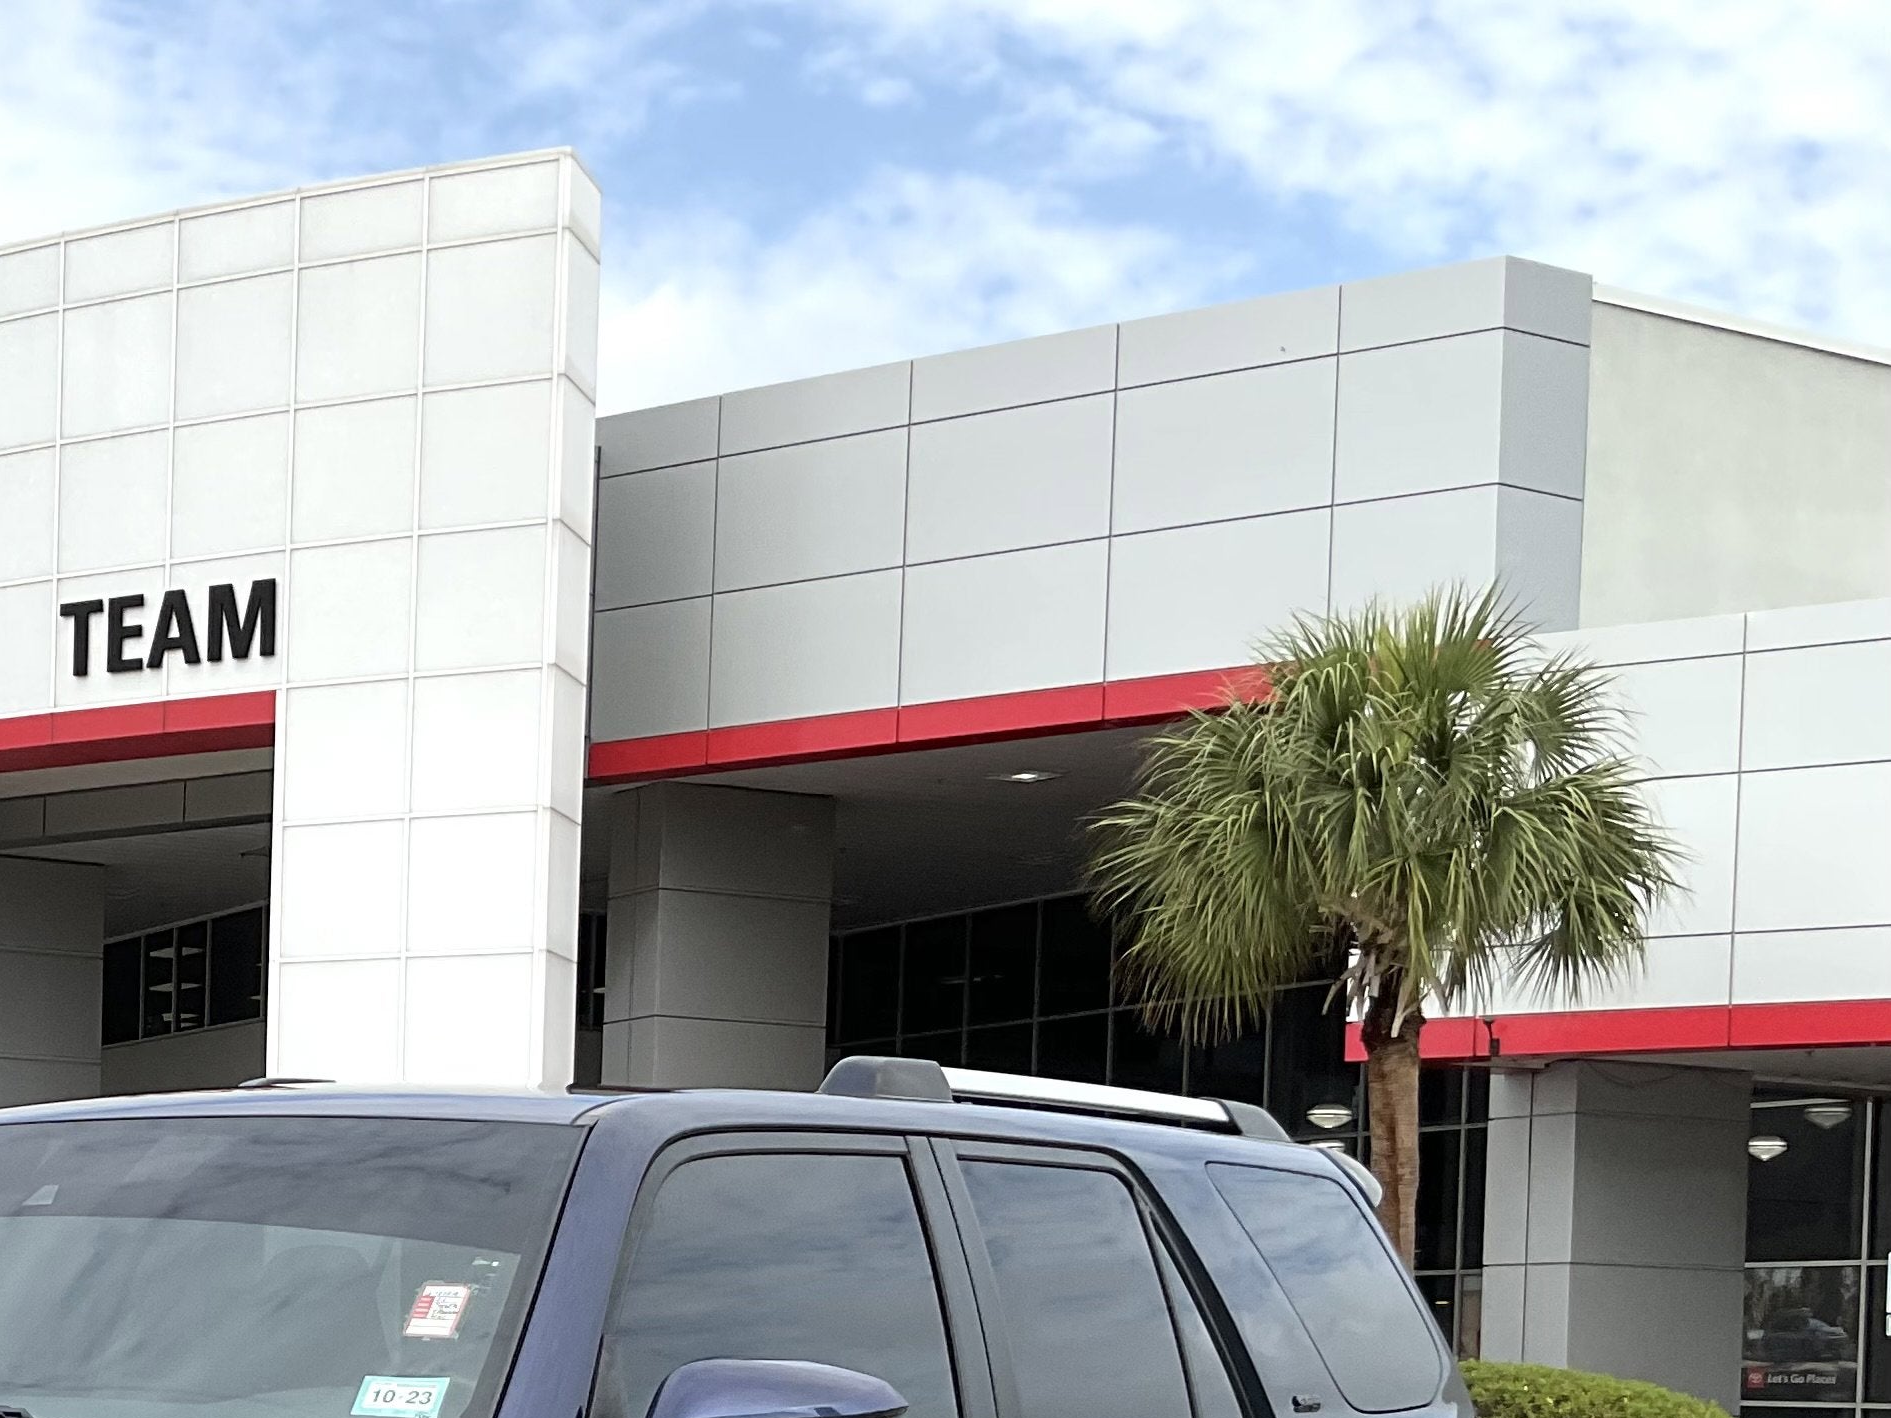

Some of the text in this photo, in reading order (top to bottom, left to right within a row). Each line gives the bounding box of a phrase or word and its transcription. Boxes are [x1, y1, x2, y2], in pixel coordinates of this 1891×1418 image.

[60, 578, 276, 677] TEAM
[1767, 1373, 1836, 1385] Let's Go Places
